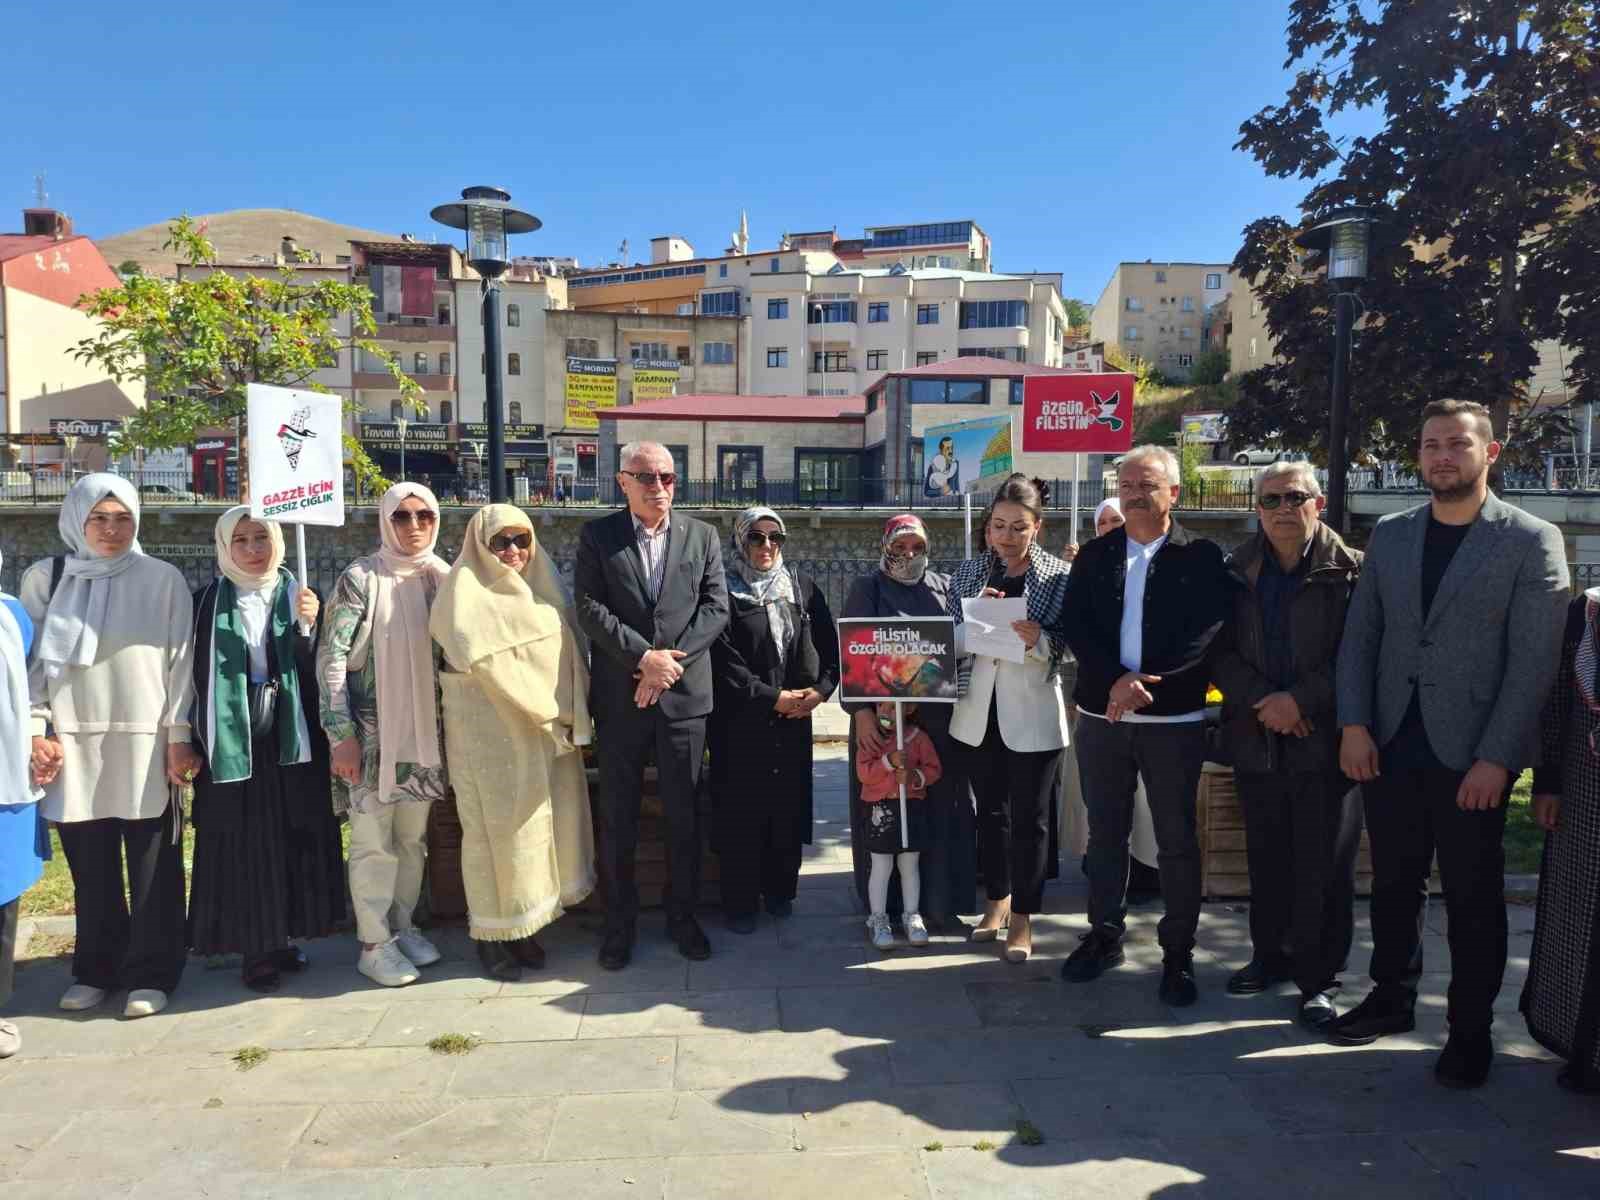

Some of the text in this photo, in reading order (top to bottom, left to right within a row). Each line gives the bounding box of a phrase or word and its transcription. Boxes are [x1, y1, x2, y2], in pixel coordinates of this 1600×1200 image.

[1042, 400, 1084, 415] ÖZGÜR
[1035, 414, 1089, 430] FİLİSTİN
[263, 480, 334, 506] GAZZE İÇİN
[263, 493, 334, 517] SESSİZ ÇIĞLIK
[872, 628, 920, 642] FİLİSTİN
[849, 641, 946, 655] ÖZGÜR OLACAK
